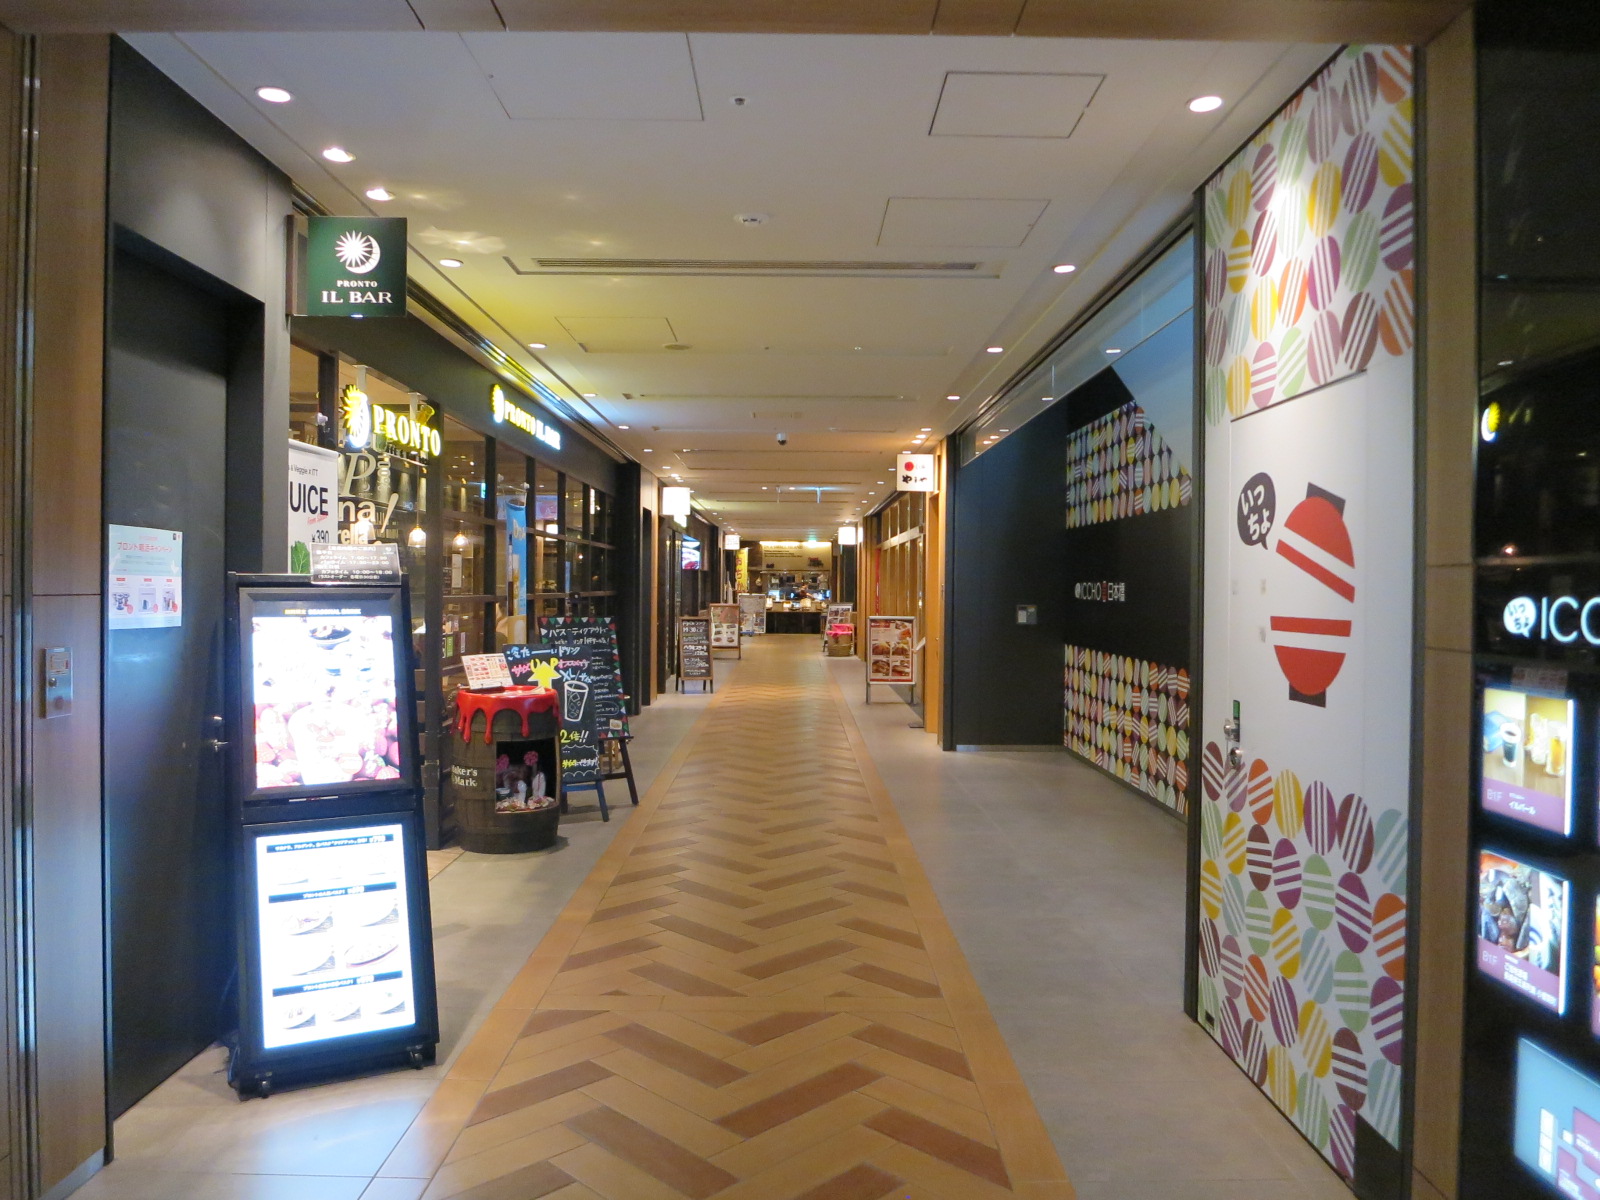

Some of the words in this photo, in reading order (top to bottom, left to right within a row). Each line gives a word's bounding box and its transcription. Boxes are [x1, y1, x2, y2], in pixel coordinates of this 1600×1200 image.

[321, 291, 344, 303] IL
[349, 291, 393, 304] BAR
[372, 404, 442, 457] PRONTO
[504, 400, 537, 436] PRONTO
